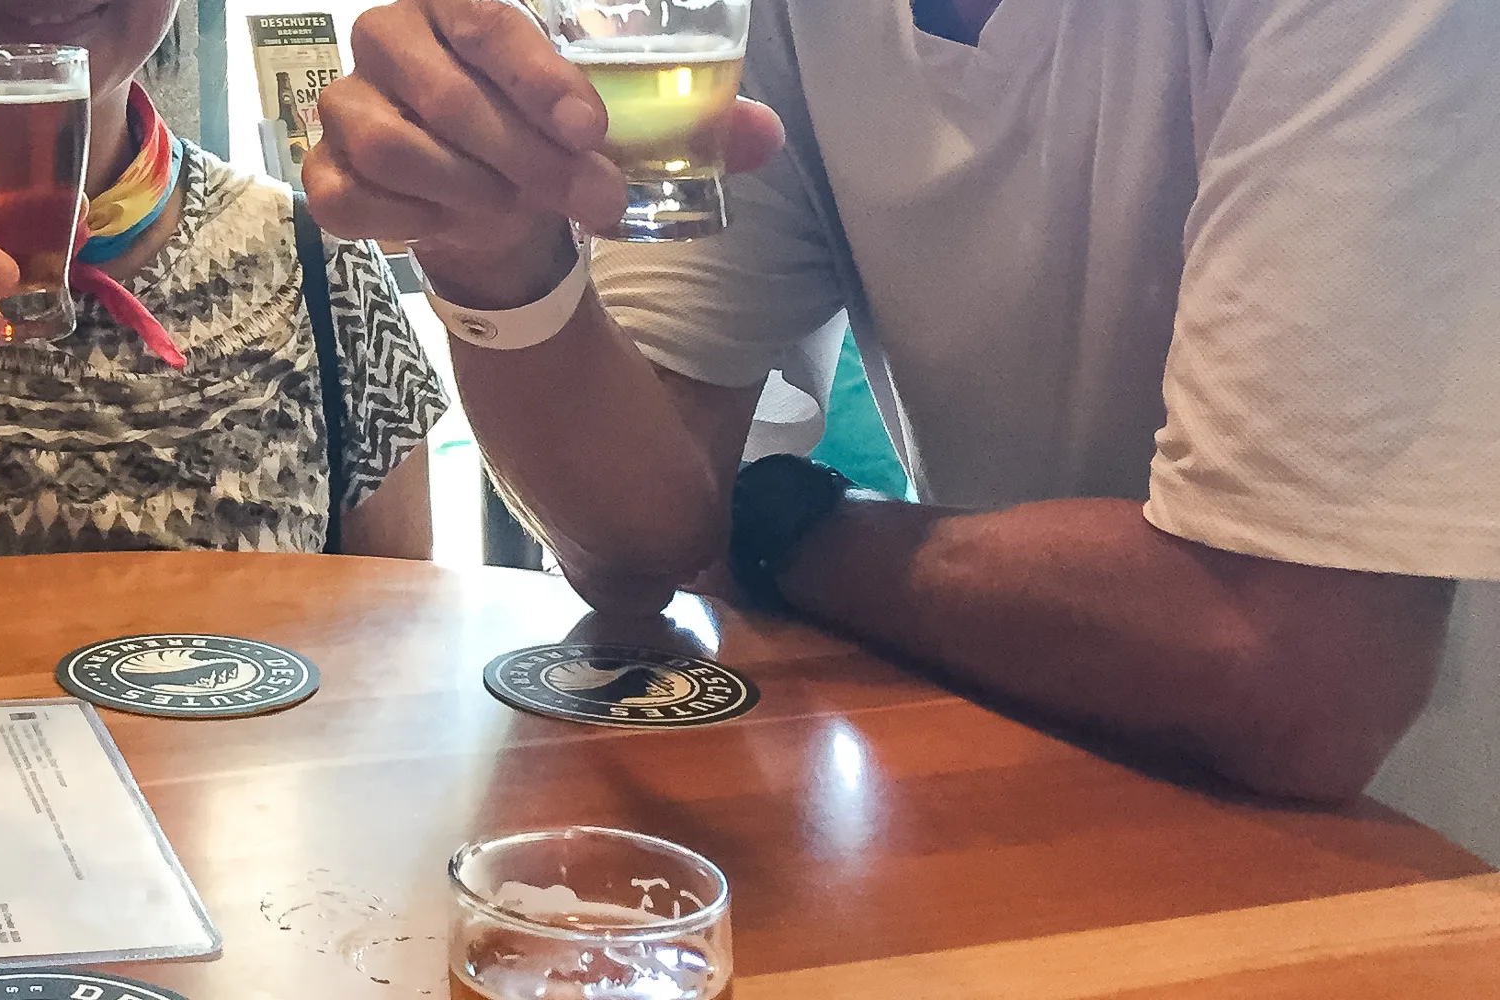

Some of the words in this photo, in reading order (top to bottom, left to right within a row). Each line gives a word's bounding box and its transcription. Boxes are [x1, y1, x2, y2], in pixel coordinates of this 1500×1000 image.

[260, 17, 327, 28] DESCHUTES
[296, 89, 324, 104] SM
[83, 638, 208, 670] BREWERY
[121, 658, 295, 706] DESCHUTES
[610, 658, 733, 718] DESCHUTES
